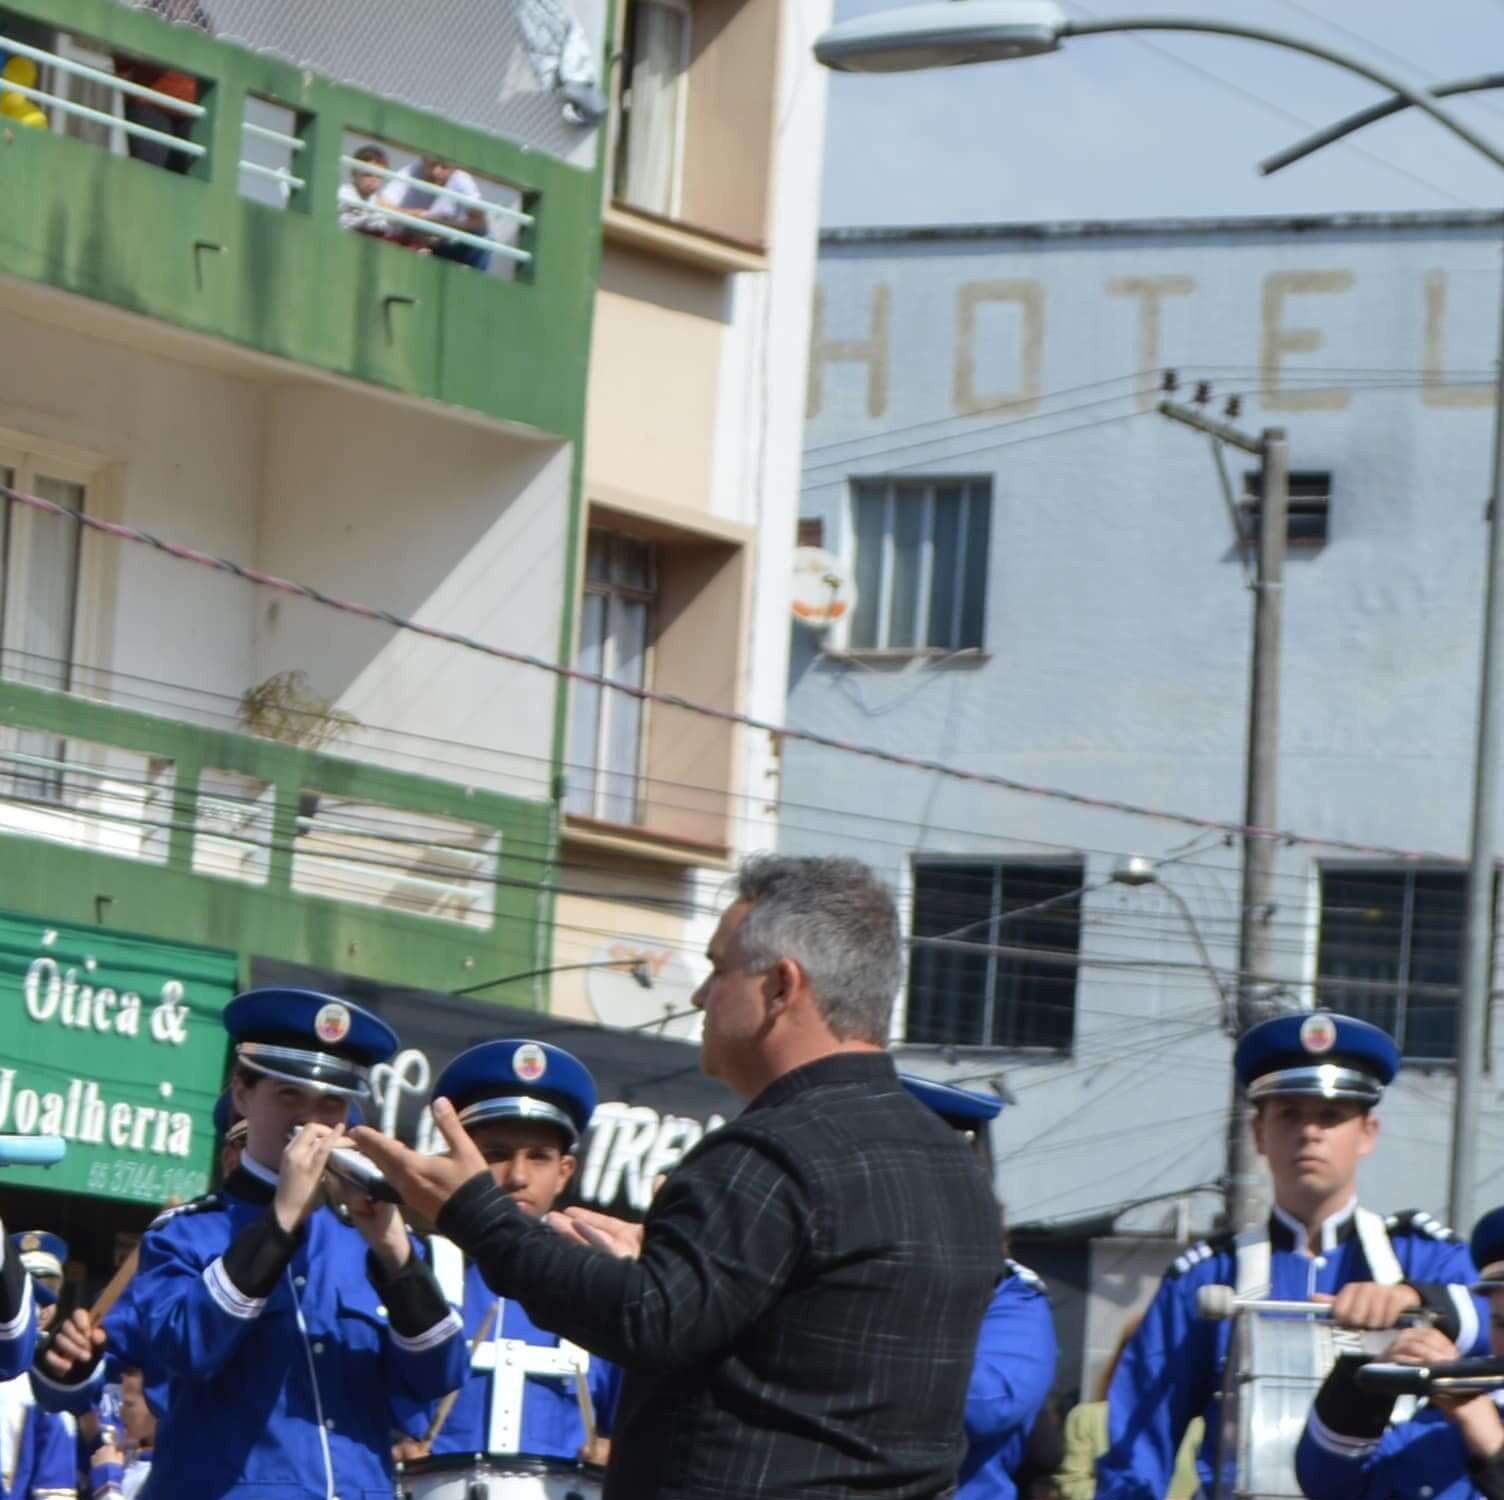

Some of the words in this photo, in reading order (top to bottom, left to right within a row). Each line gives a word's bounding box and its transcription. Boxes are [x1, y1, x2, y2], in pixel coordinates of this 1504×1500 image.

[803, 269, 1501, 419] HOTEL
[24, 929, 142, 1037] Ótica
[150, 980, 191, 1044] &
